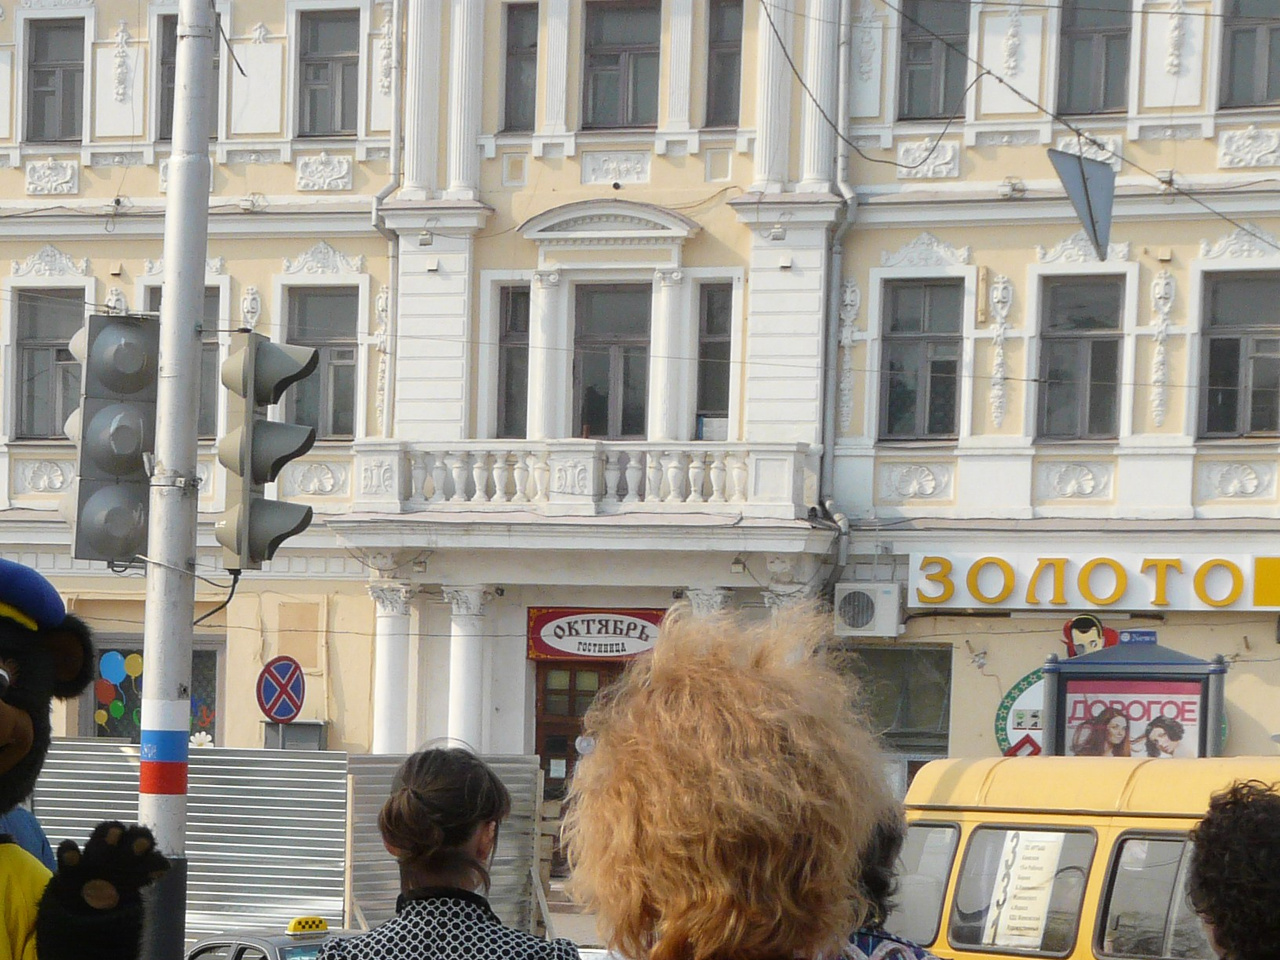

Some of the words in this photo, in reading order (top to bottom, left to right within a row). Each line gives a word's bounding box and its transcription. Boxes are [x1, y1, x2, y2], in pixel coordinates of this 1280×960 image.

[916, 556, 1245, 606] ЗОЛОТО
[553, 619, 650, 642] ОКТЯБРЬ
[577, 642, 627, 653] ГОСТИНИЦА
